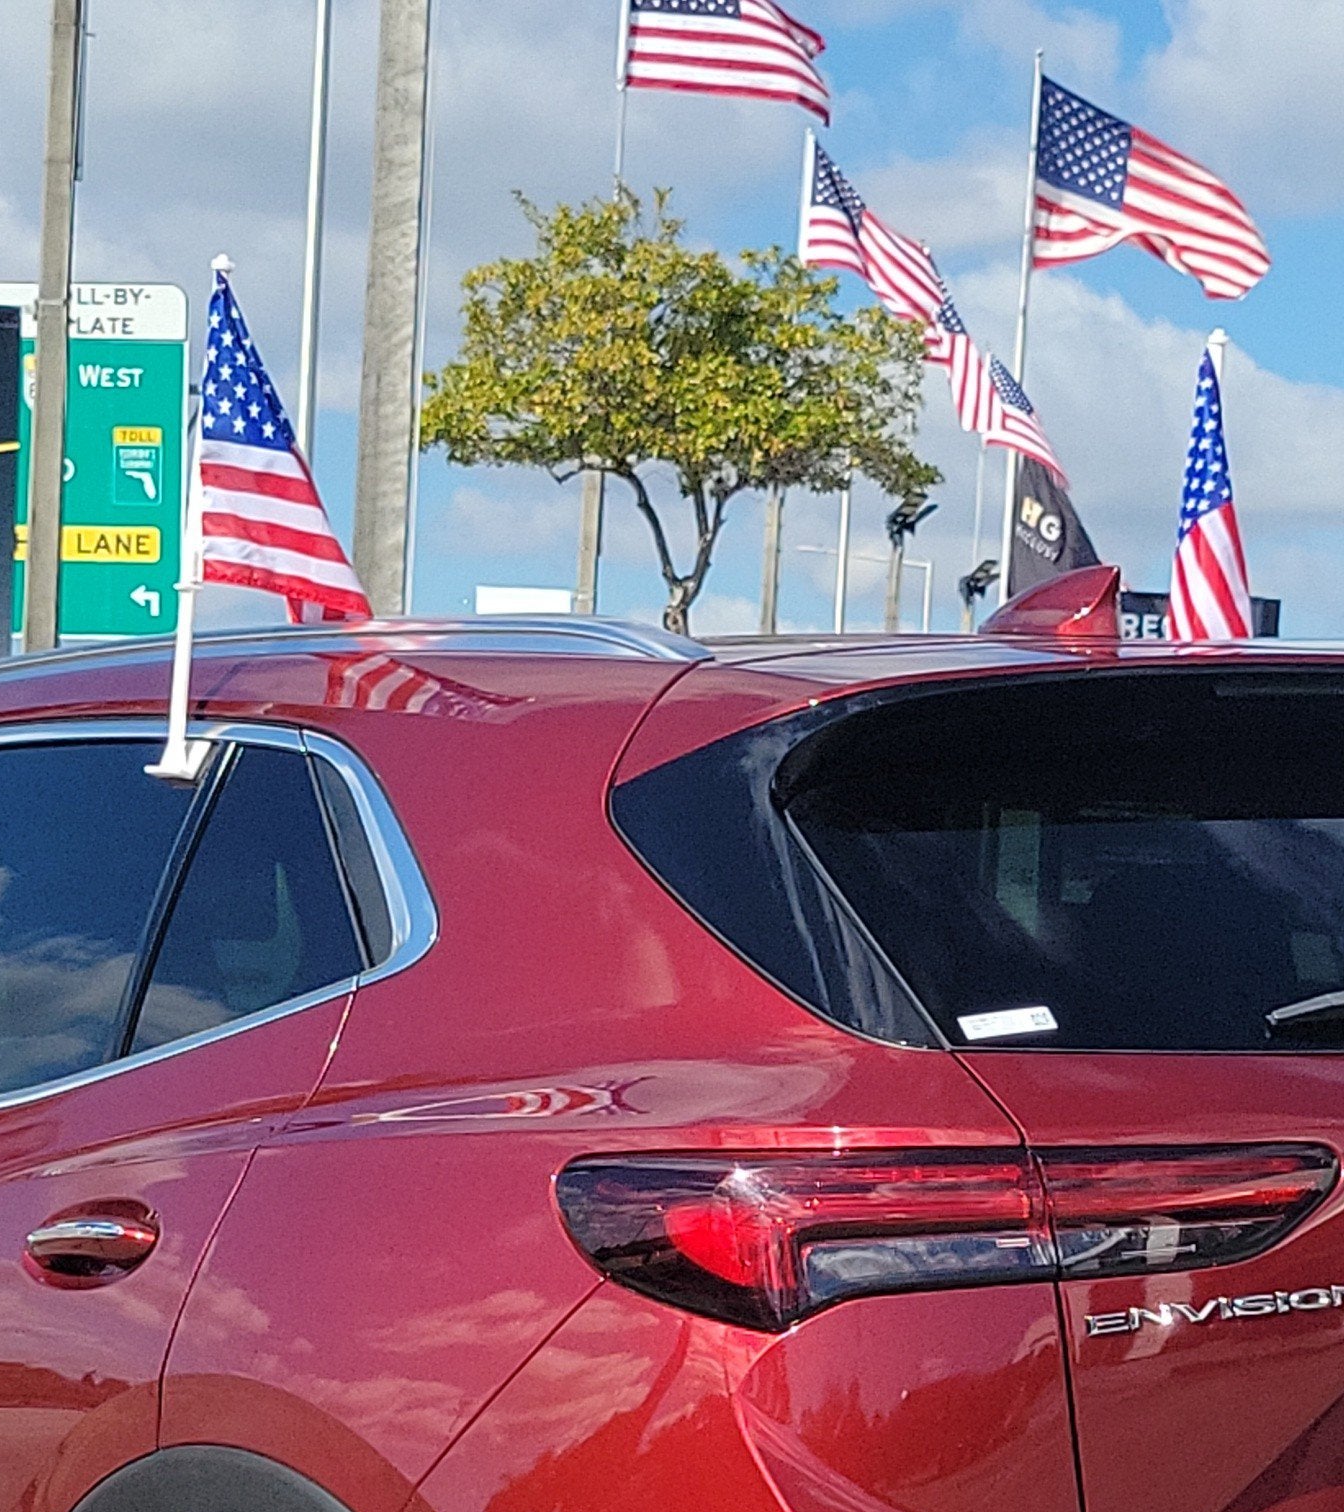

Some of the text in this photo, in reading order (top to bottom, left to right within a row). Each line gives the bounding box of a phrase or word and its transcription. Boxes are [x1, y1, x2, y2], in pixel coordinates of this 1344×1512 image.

[77, 363, 145, 388] WEST
[119, 430, 156, 443] TOLL
[76, 533, 152, 556] LANE
